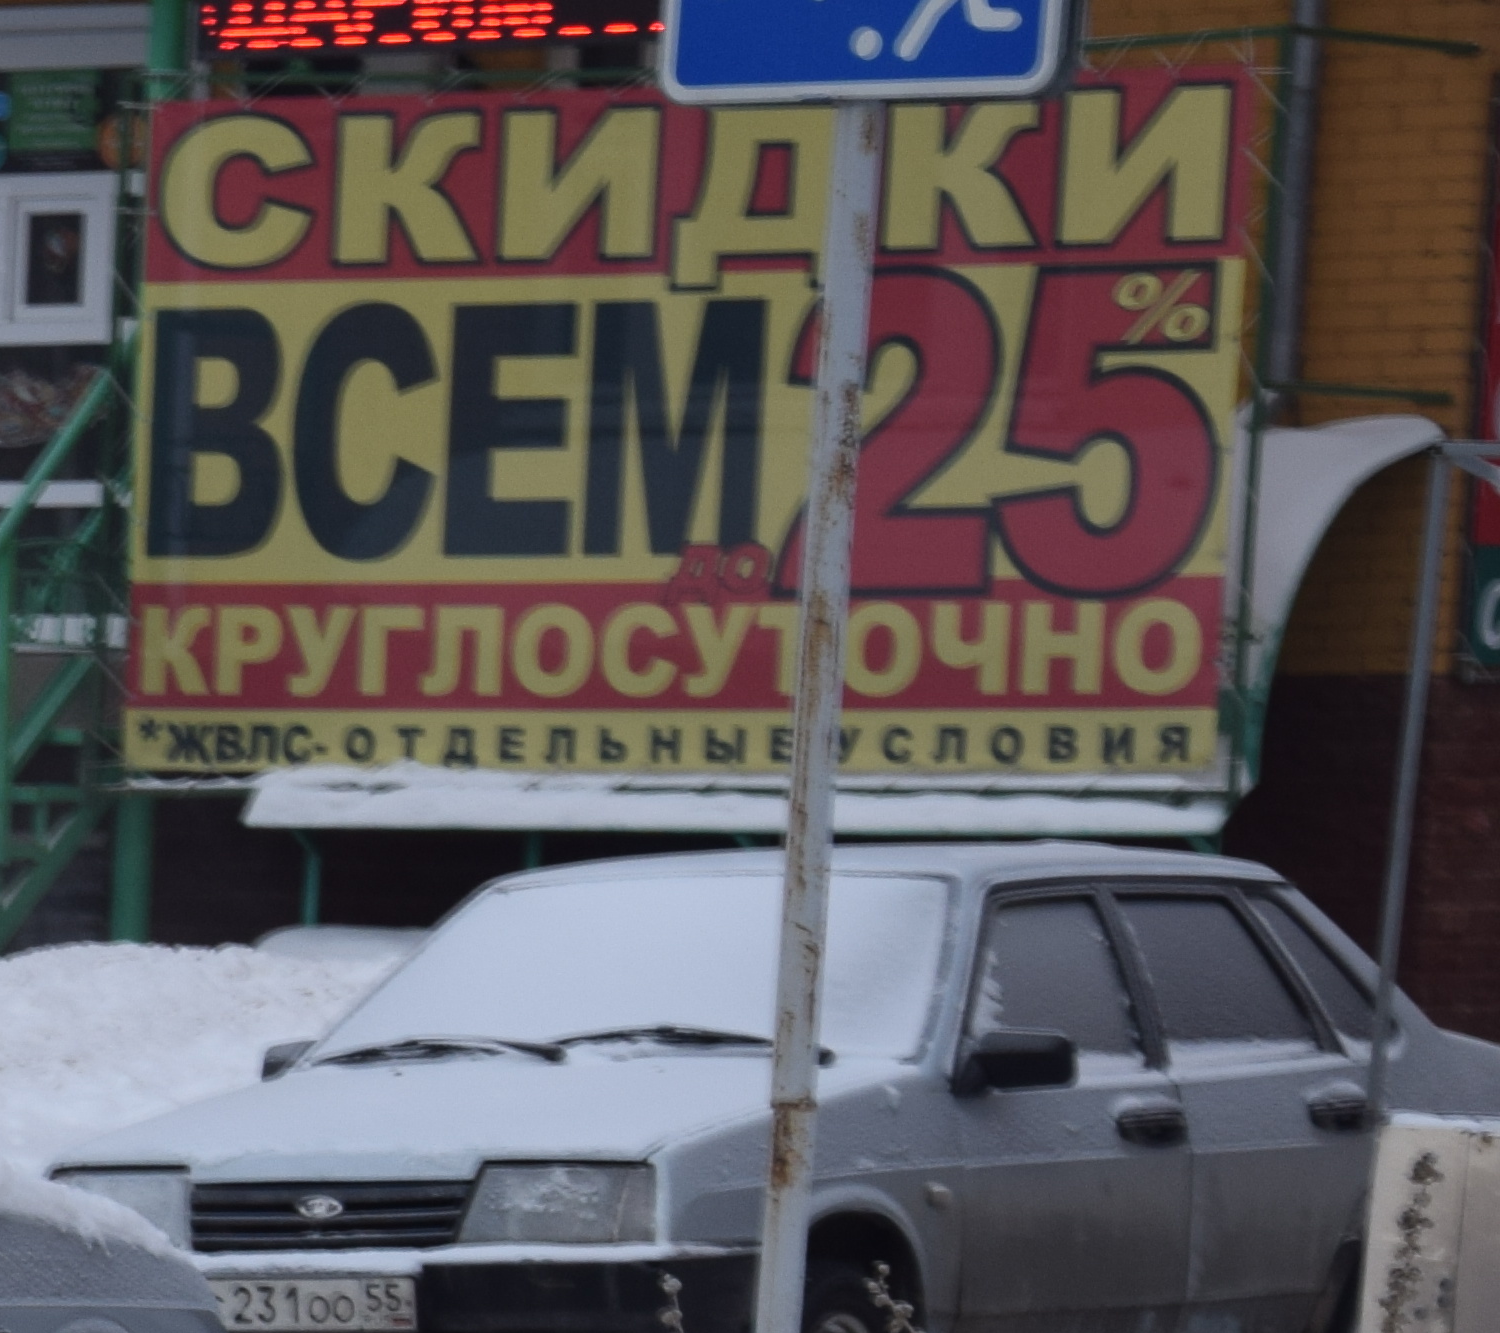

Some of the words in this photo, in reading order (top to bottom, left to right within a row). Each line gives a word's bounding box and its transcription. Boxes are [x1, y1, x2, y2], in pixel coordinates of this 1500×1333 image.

[156, 83, 1234, 291] СКИДКИ
[146, 297, 770, 562] ВСЕМ
[138, 599, 1204, 702] КРУГЛОСУТОЧНО
[216, 1286, 356, 1325] 231ОО
[366, 1282, 402, 1313] 55
